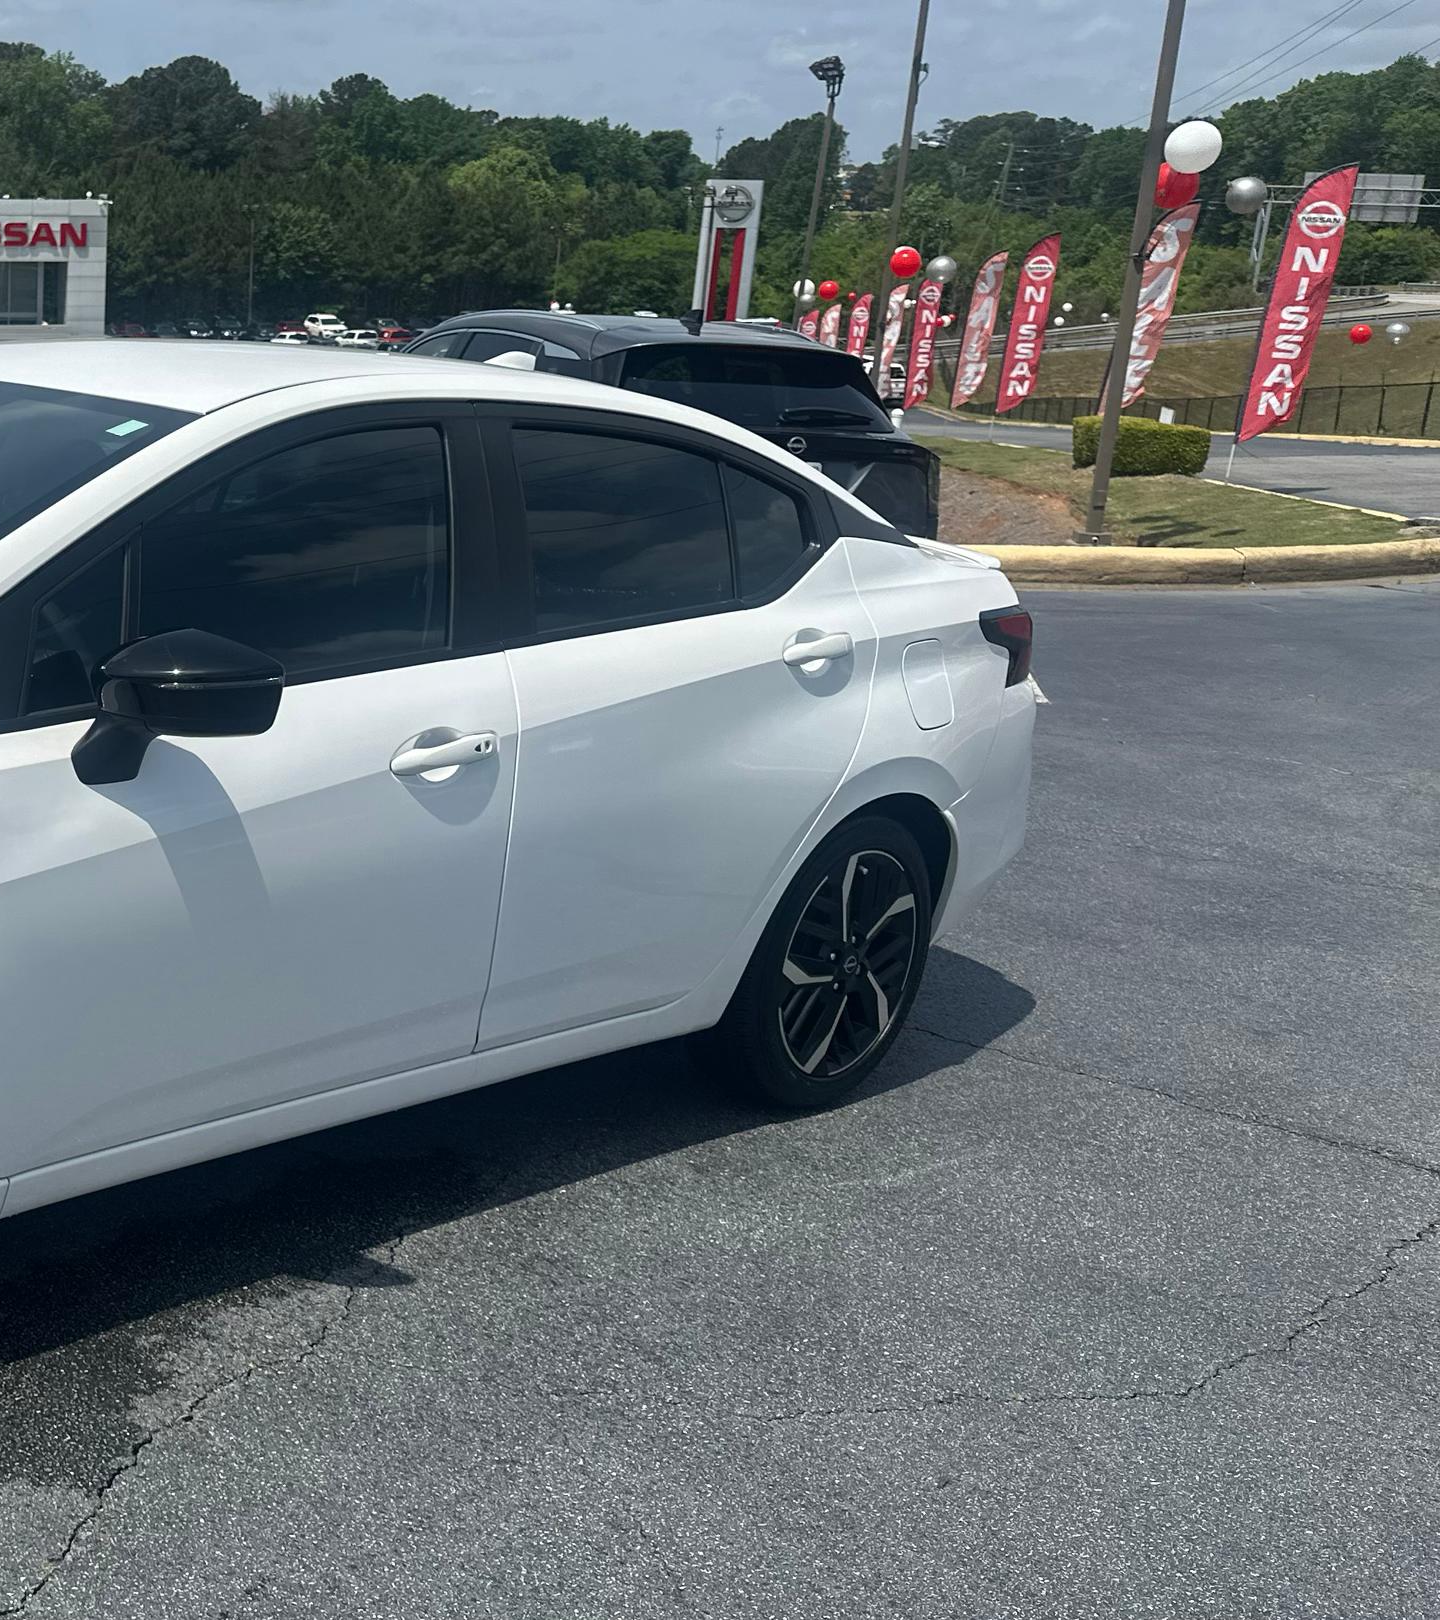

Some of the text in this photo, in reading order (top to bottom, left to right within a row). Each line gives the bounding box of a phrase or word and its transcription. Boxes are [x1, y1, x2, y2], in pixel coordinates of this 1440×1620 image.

[912, 309, 937, 396] NISSAN
[1006, 286, 1047, 397] NISSAN
[1257, 246, 1330, 417] NISSAN
